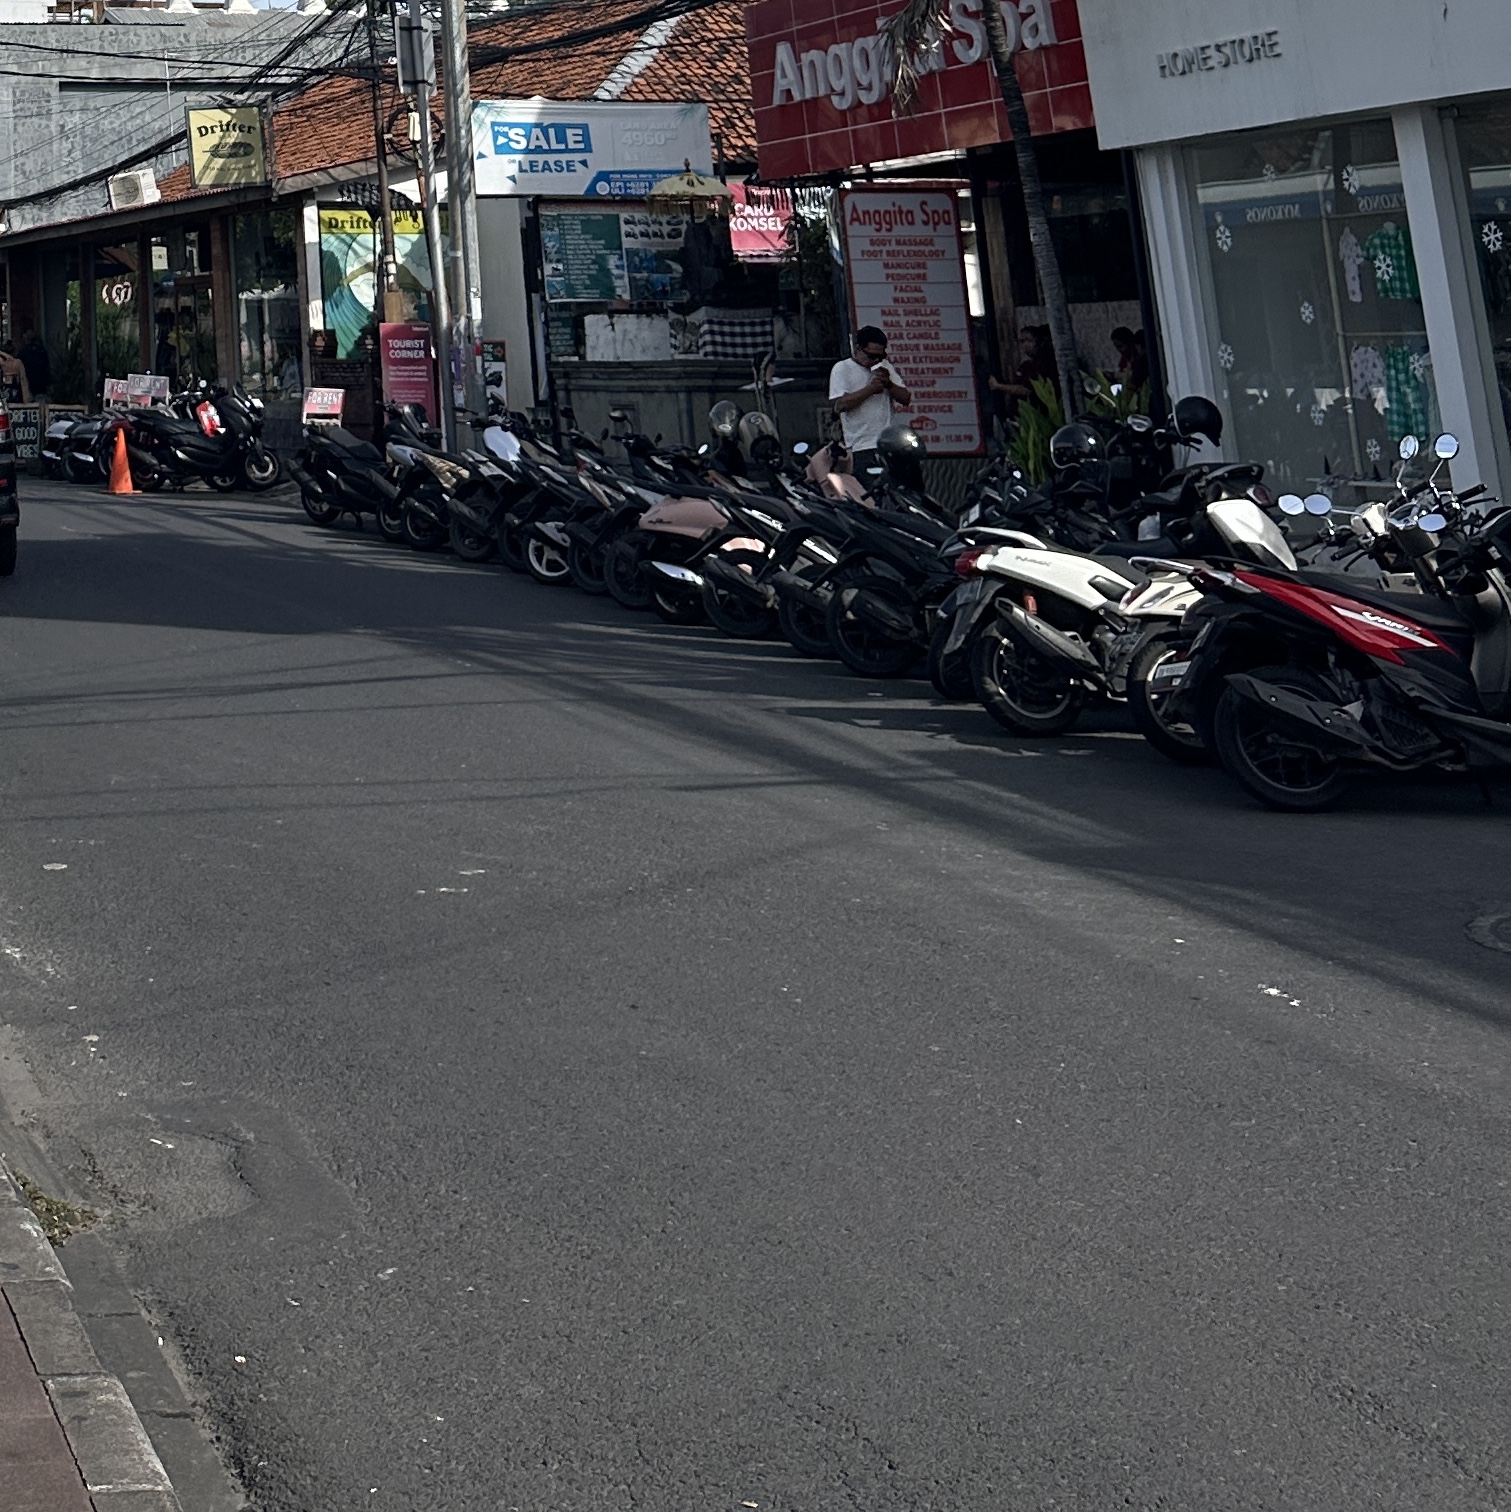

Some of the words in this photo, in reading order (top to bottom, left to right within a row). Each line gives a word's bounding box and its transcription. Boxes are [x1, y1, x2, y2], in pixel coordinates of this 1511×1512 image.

[1156, 45, 1214, 78] HOME
[1214, 30, 1283, 67] STORE
[196, 119, 257, 139] Drifter
[494, 125, 509, 133] FOR
[508, 126, 586, 150] SALE
[518, 159, 577, 173] LEASE
[849, 201, 915, 233] Anggita
[920, 200, 953, 232] Spa
[869, 238, 892, 247] BODY
[895, 238, 935, 247] MASSAGE
[861, 249, 883, 258] FOOT
[883, 262, 928, 270] MANICURE
[885, 273, 928, 281] PEDICURE
[893, 285, 924, 293] FACIAL
[892, 296, 927, 304] WAXING
[881, 308, 901, 316] NAIL
[883, 319, 903, 328] NAIL
[905, 319, 942, 328] ACRYLIC
[388, 339, 425, 348] TOURIST
[389, 350, 425, 359] CORNER
[913, 355, 961, 364] EXTENSION
